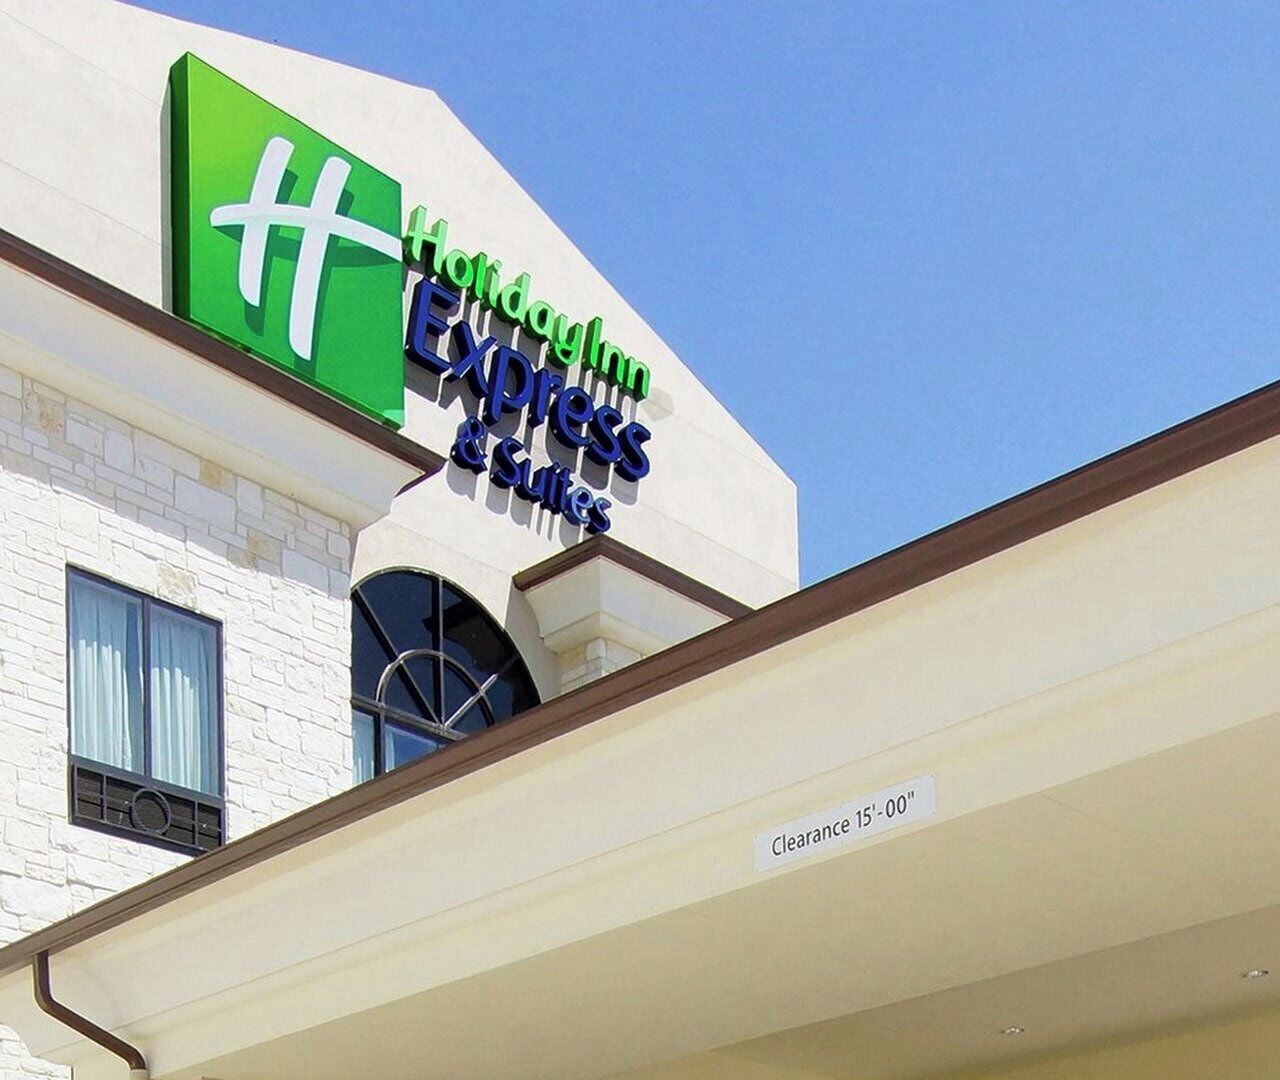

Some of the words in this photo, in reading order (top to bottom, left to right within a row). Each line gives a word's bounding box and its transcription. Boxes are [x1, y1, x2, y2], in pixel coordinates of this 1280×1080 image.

[404, 276, 652, 482] Express
[450, 416, 488, 475] &
[489, 437, 612, 535] Suites
[771, 818, 850, 856] Clearance
[856, 790, 915, 829] 15'-00"
